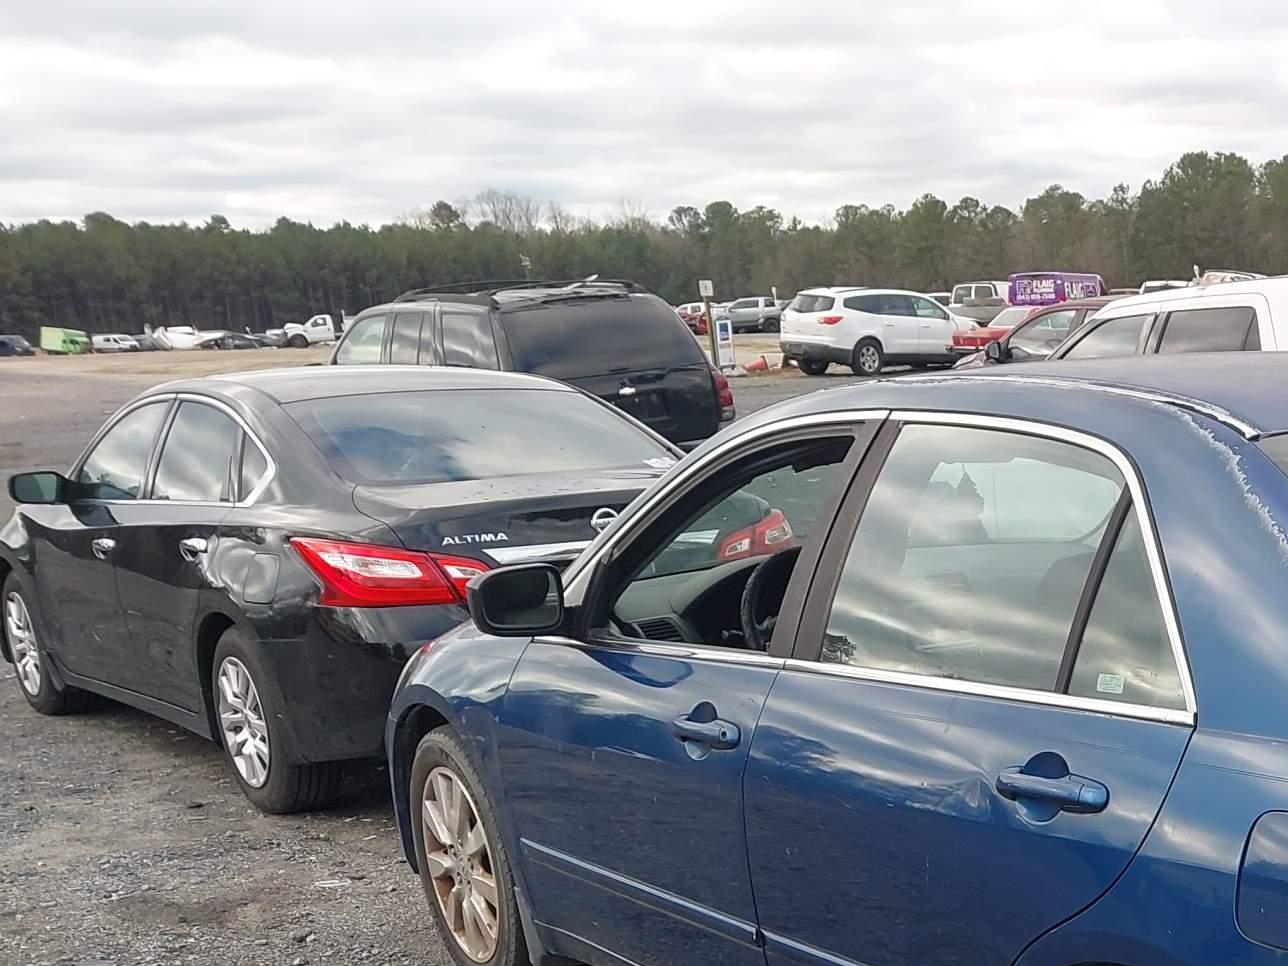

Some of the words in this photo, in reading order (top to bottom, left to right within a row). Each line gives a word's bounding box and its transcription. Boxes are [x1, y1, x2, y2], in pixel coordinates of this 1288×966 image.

[1033, 279, 1055, 288] FLAIG
[1064, 281, 1085, 298] FLAIG
[442, 533, 508, 546] ALTIMA
